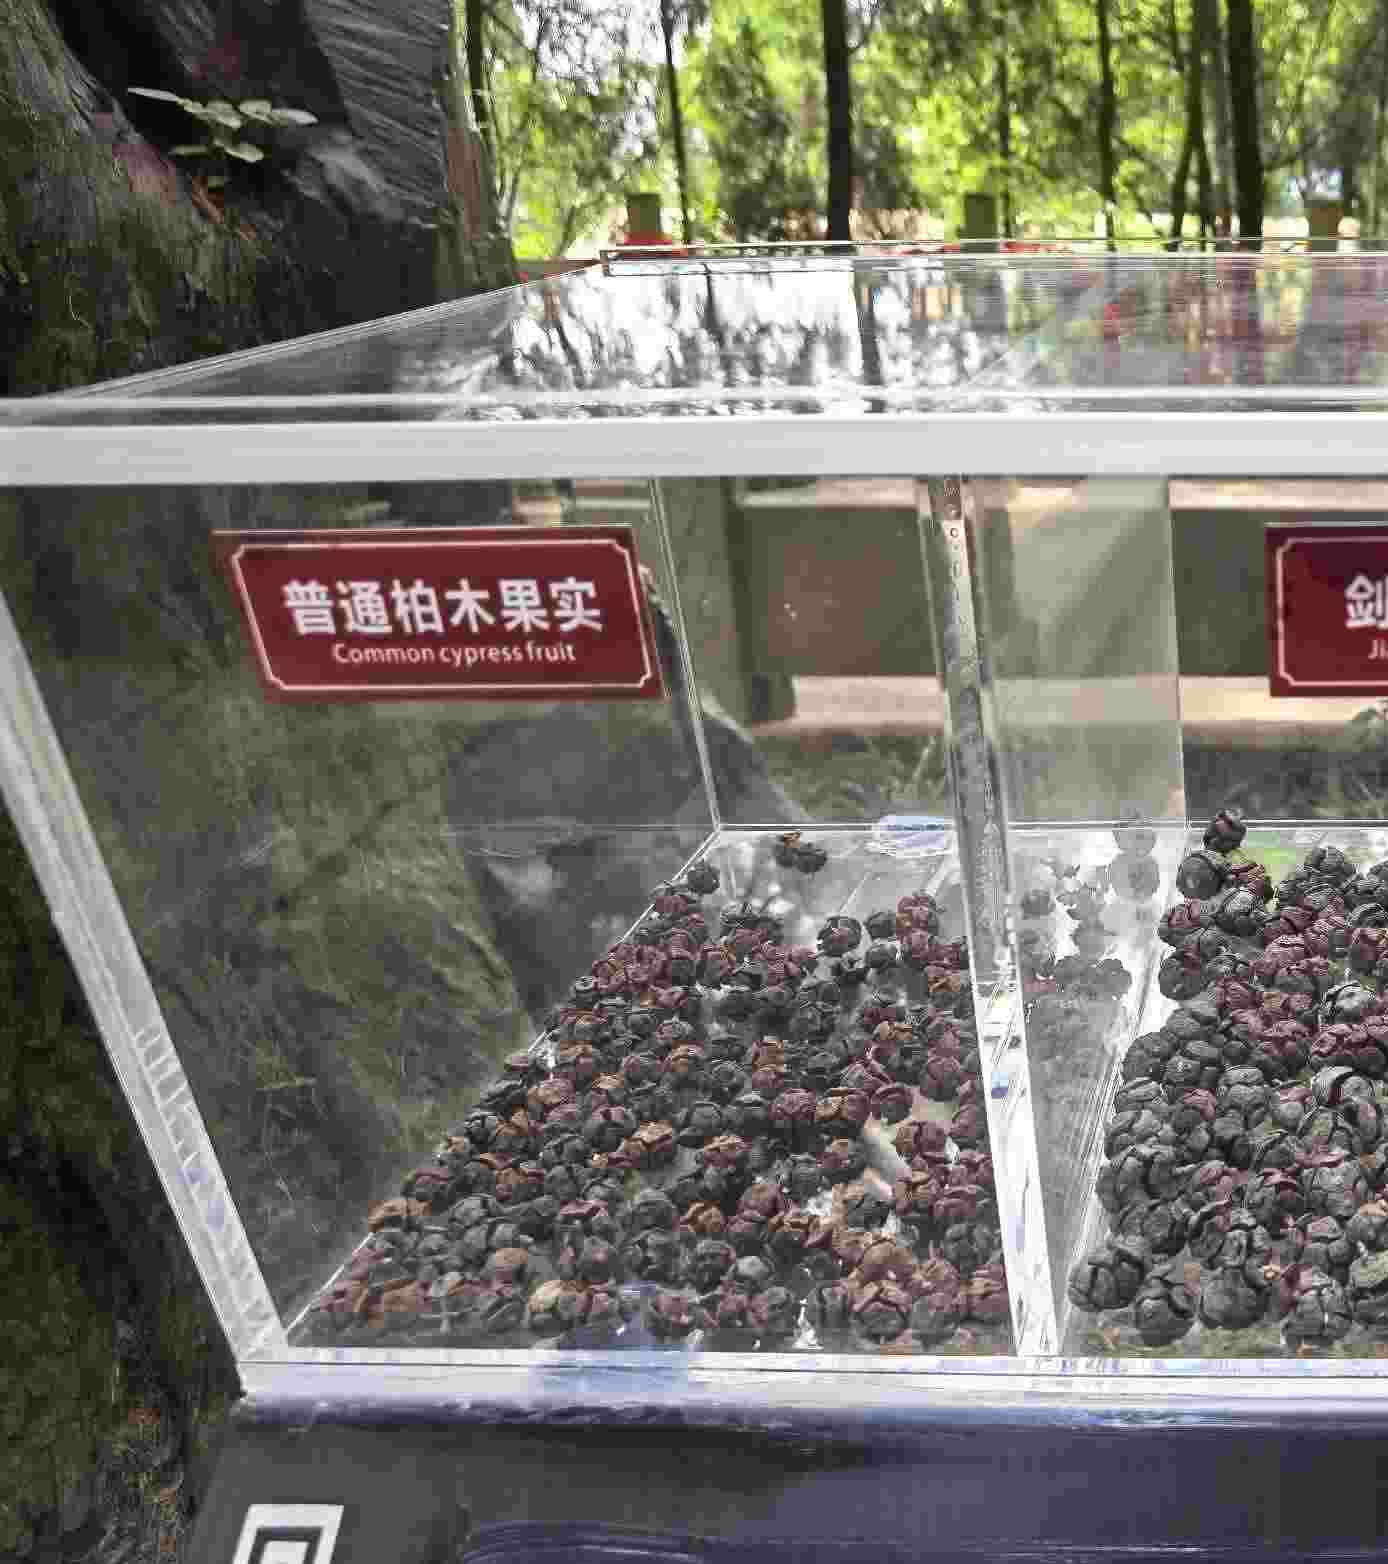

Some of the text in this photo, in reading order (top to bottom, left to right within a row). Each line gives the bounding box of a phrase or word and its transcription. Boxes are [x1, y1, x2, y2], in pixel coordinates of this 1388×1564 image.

[282, 577, 604, 636] 普通柏木果实
[332, 642, 577, 667] Common cypress fruit
